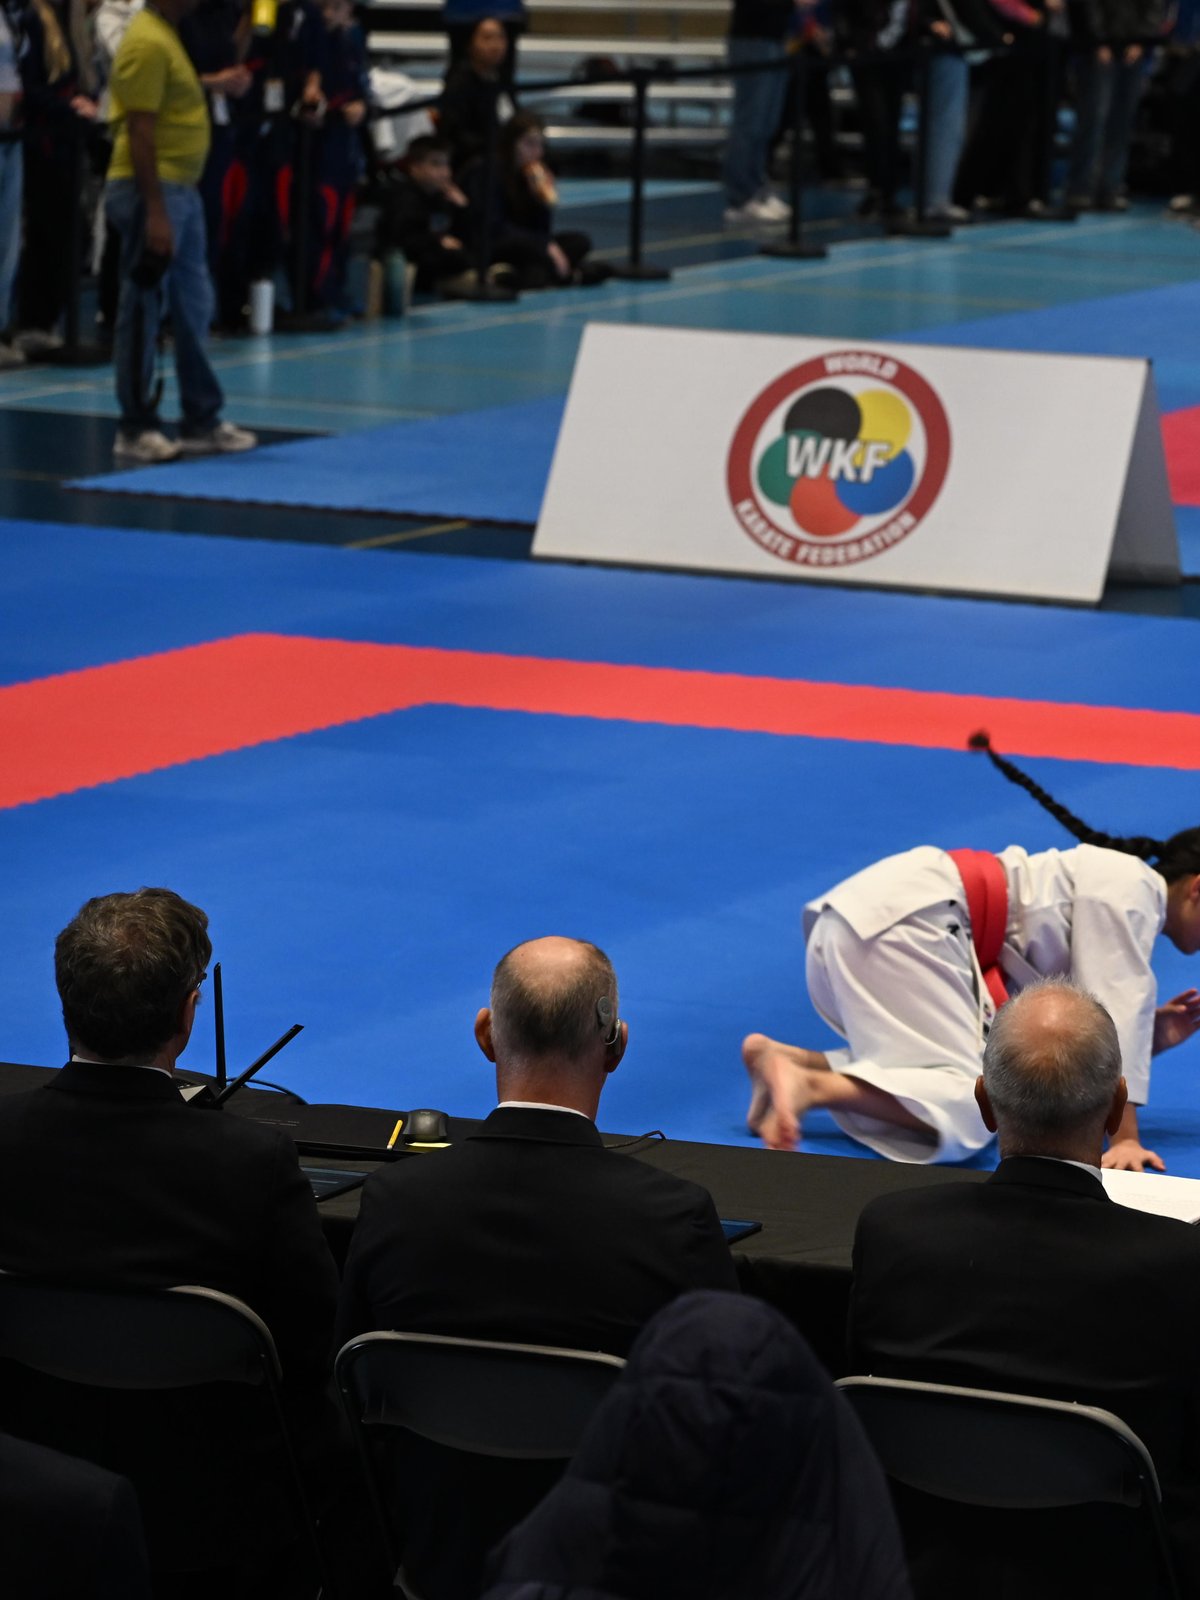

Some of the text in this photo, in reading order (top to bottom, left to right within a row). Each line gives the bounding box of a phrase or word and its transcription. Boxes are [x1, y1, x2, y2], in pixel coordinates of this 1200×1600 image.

[823, 353, 899, 379] WORLD
[786, 435, 893, 483] WKF
[735, 498, 918, 565] KARATE FEDERATION
